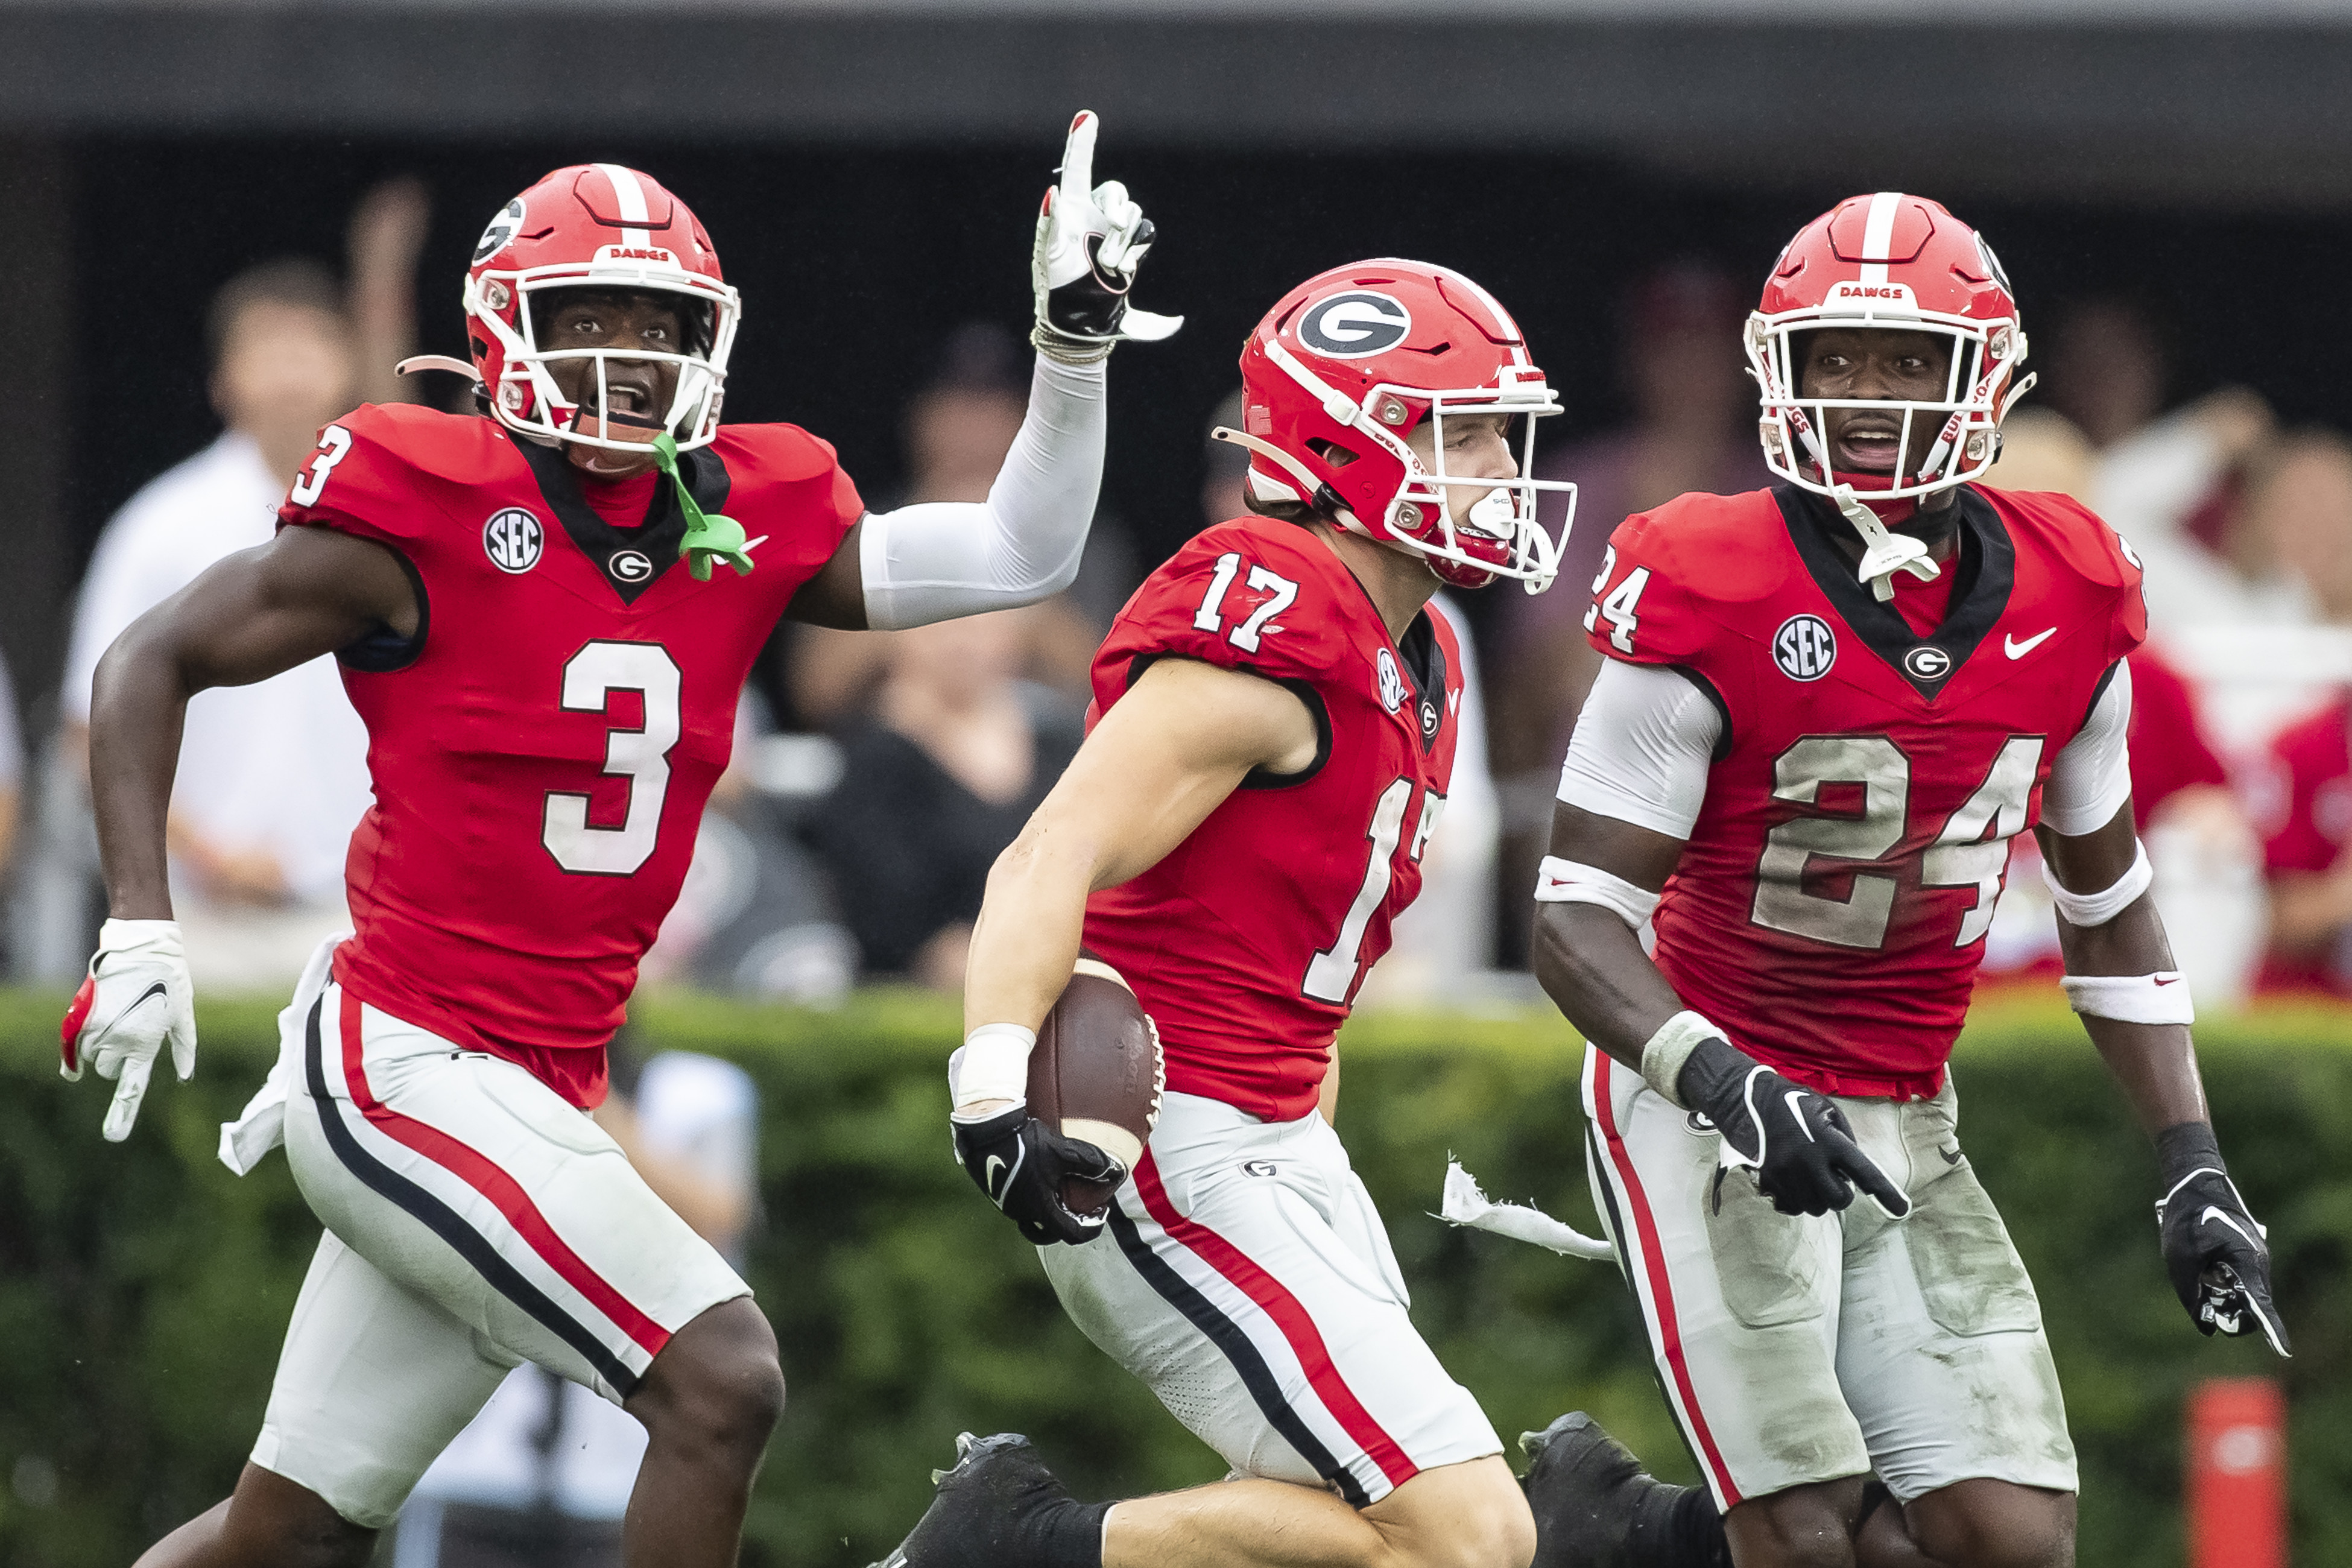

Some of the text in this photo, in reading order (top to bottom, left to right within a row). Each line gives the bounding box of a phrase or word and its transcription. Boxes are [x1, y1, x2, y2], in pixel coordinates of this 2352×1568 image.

[610, 248, 669, 261] DAWGS
[1840, 286, 1903, 299] DAWGS
[1300, 294, 1406, 353] G
[291, 423, 353, 508] 3
[488, 513, 539, 568] SEC
[610, 551, 651, 581] G
[1191, 552, 1300, 655] 17
[1778, 619, 1832, 676] SEC
[1906, 648, 1949, 678] G
[1421, 703, 1437, 734] G
[540, 637, 683, 877] 3
[1750, 733, 2047, 950] 24
[1244, 1160, 1277, 1177] G
